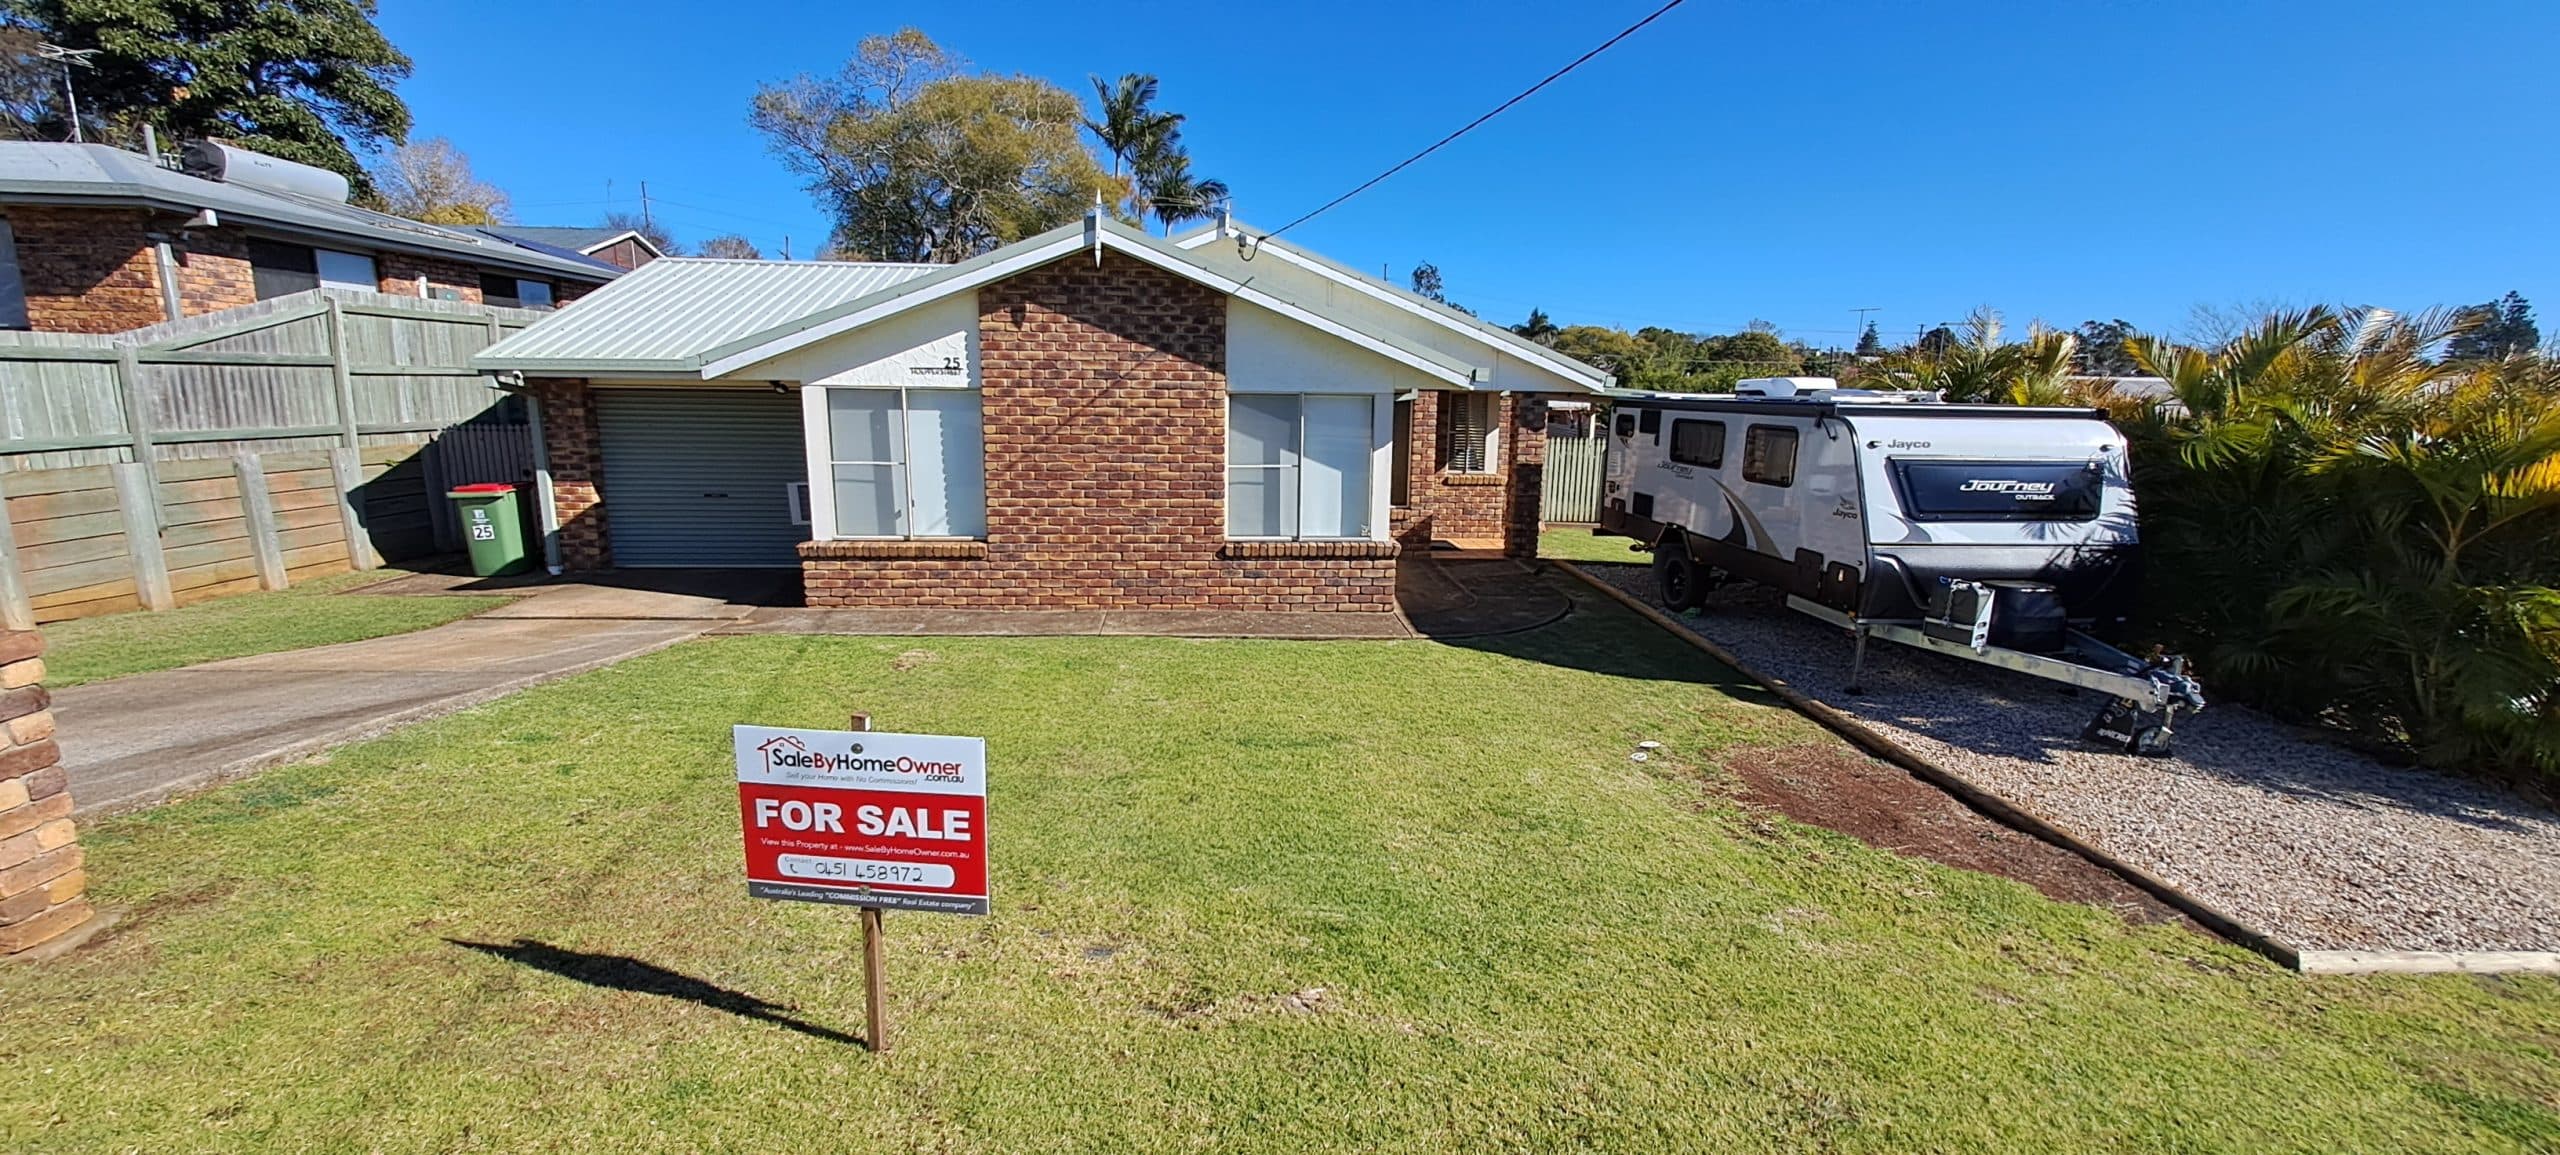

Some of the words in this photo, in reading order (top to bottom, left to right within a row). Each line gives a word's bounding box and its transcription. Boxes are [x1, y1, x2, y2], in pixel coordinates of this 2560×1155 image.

[943, 357, 961, 369] 25
[1887, 439, 1931, 450] Jayco
[1960, 480, 2055, 493] Journey
[1832, 508, 1858, 519] Jayco
[474, 527, 493, 538] 25
[773, 748, 962, 775] SaleByHomeOwner
[801, 773, 816, 781] your
[925, 774, 965, 784] .com.au
[755, 798, 845, 833] FOR
[857, 805, 971, 840] SALE
[761, 838, 779, 847] View
[781, 839, 795, 847] this
[796, 840, 828, 850] Property
[844, 845, 970, 858] www.SaleByHomeOwner.com.au
[815, 862, 847, 875] 0451
[855, 864, 923, 882] 458972
[797, 890, 823, 899] Leading
[918, 899, 940, 907] Estate
